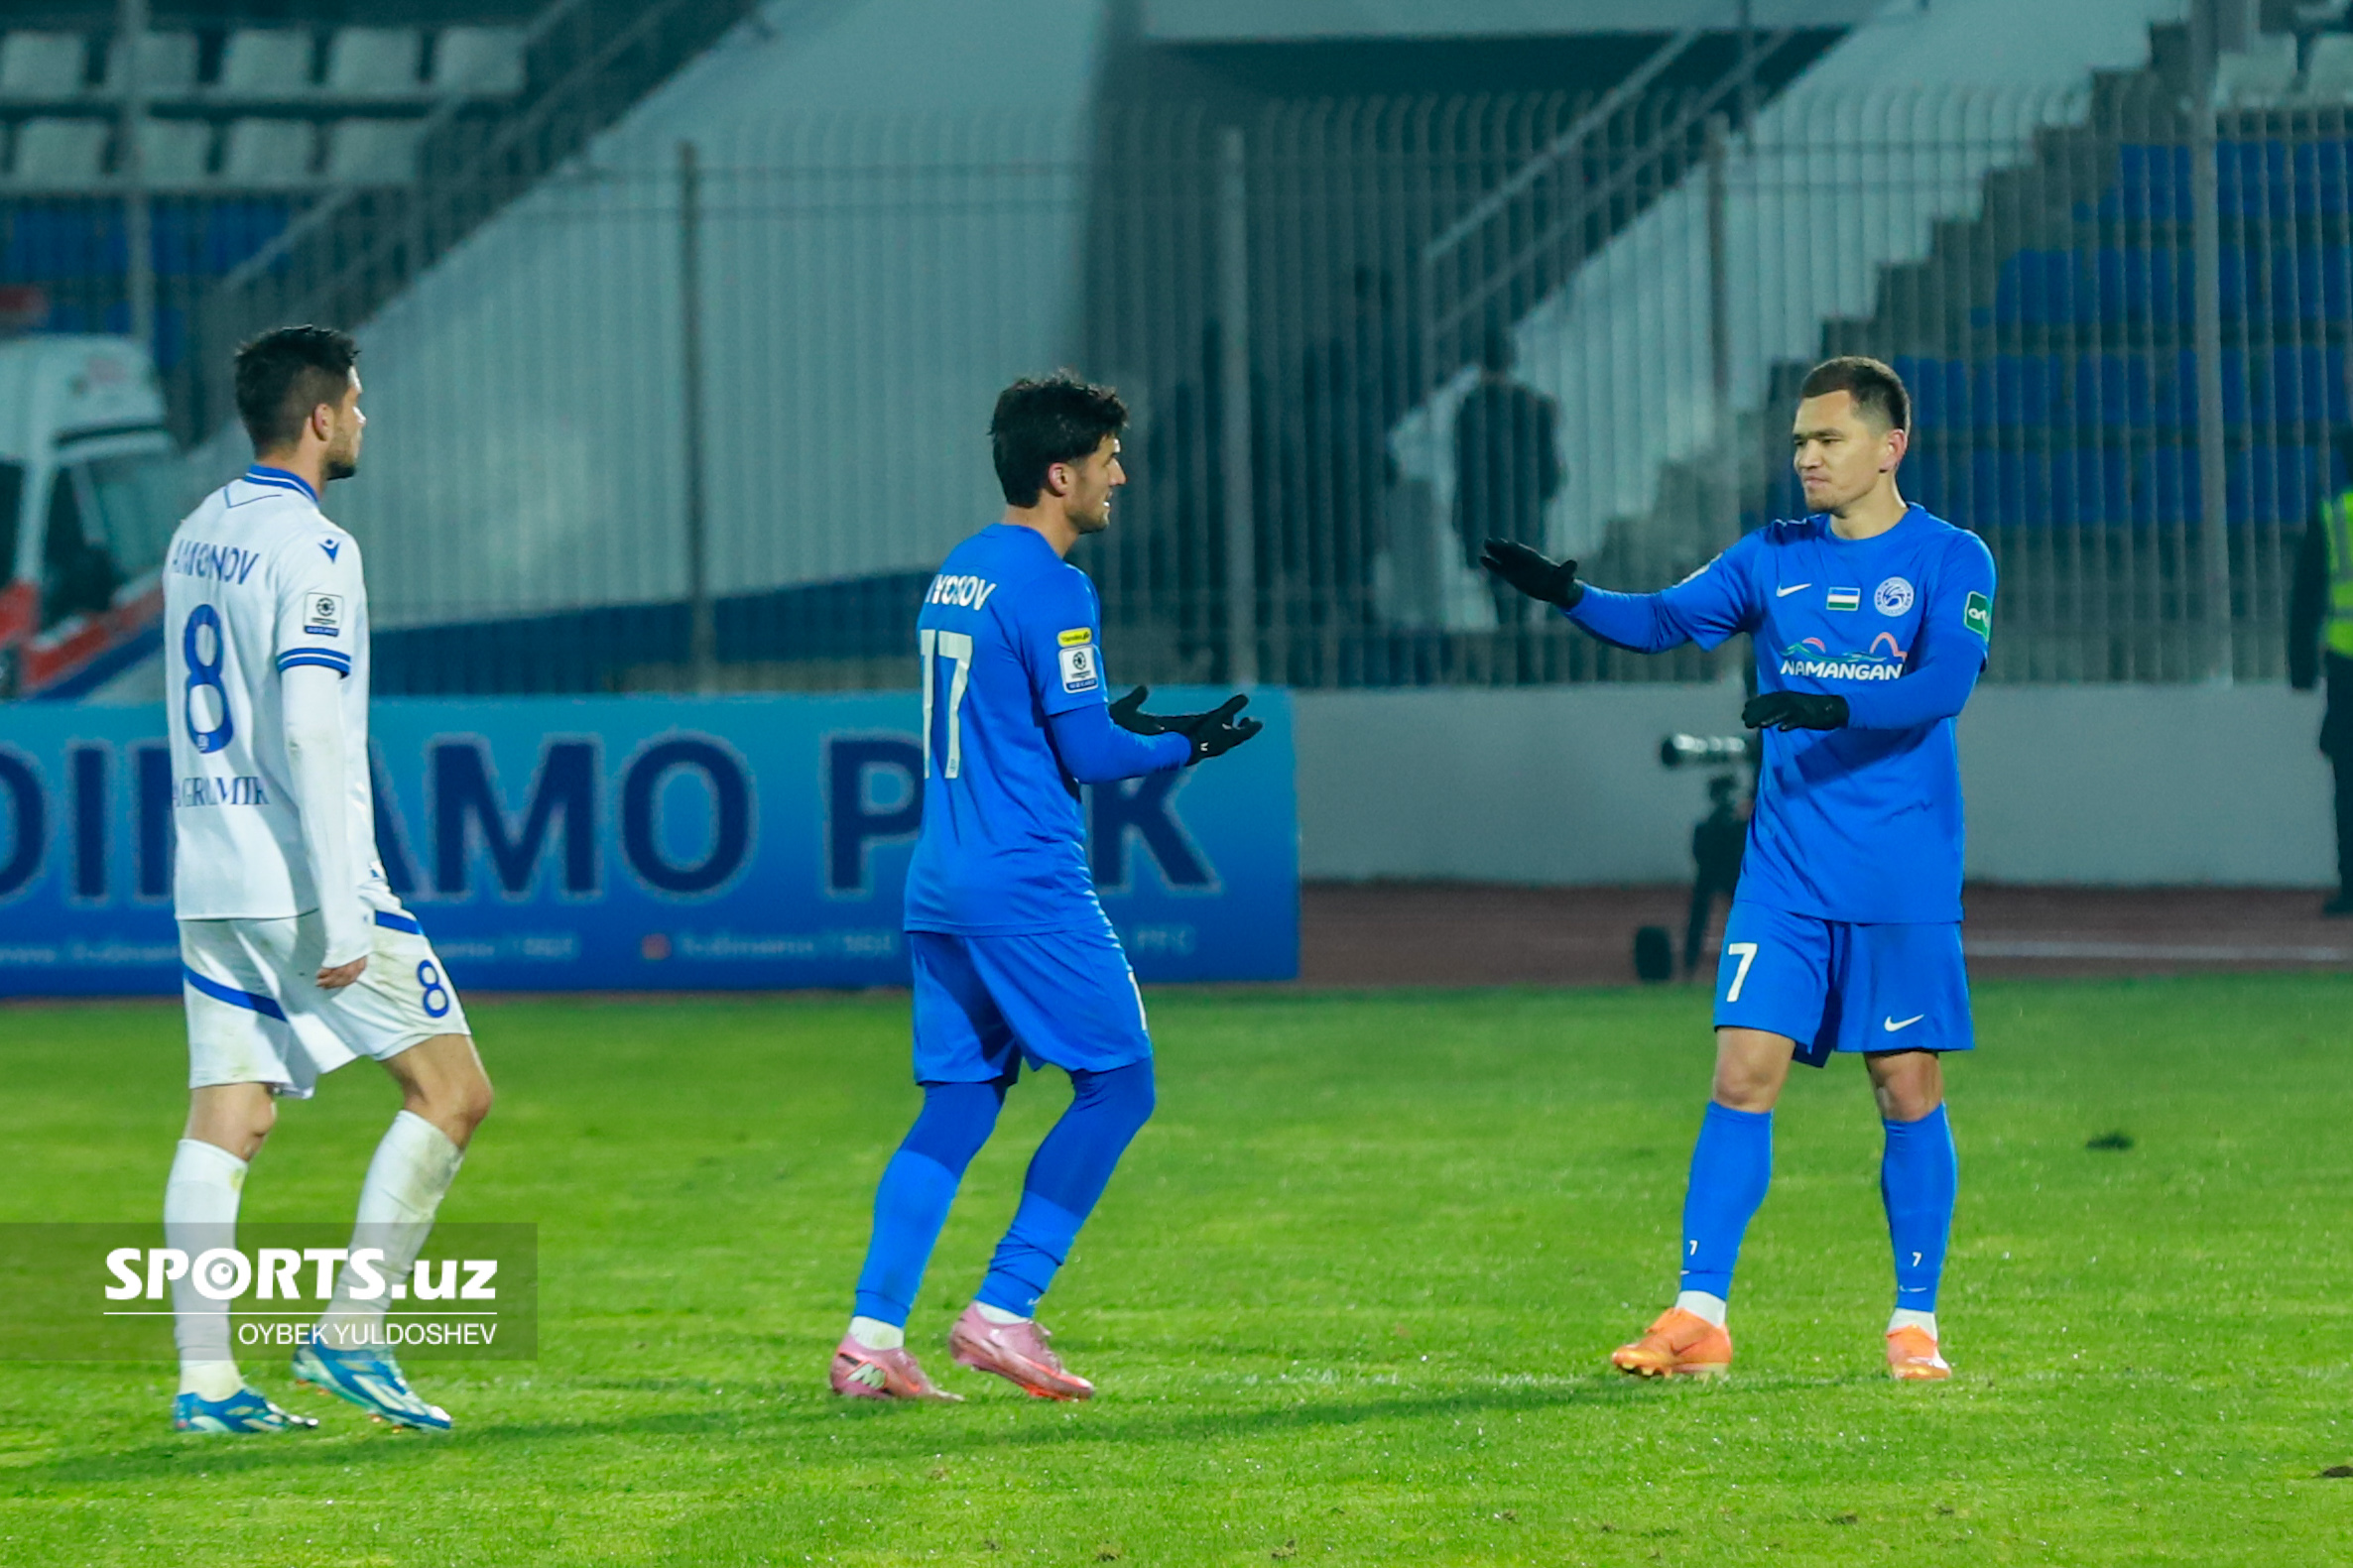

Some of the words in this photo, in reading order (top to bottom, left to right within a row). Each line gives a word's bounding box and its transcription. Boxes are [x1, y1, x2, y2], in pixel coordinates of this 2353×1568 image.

[183, 604, 234, 754] 8
[1780, 660, 1905, 681] NAMANGAN
[920, 629, 973, 779] 17
[417, 959, 450, 1019] 8
[1727, 942, 1759, 1003] 7
[1688, 1240, 1698, 1257] 7
[1912, 1252, 1922, 1267] 7
